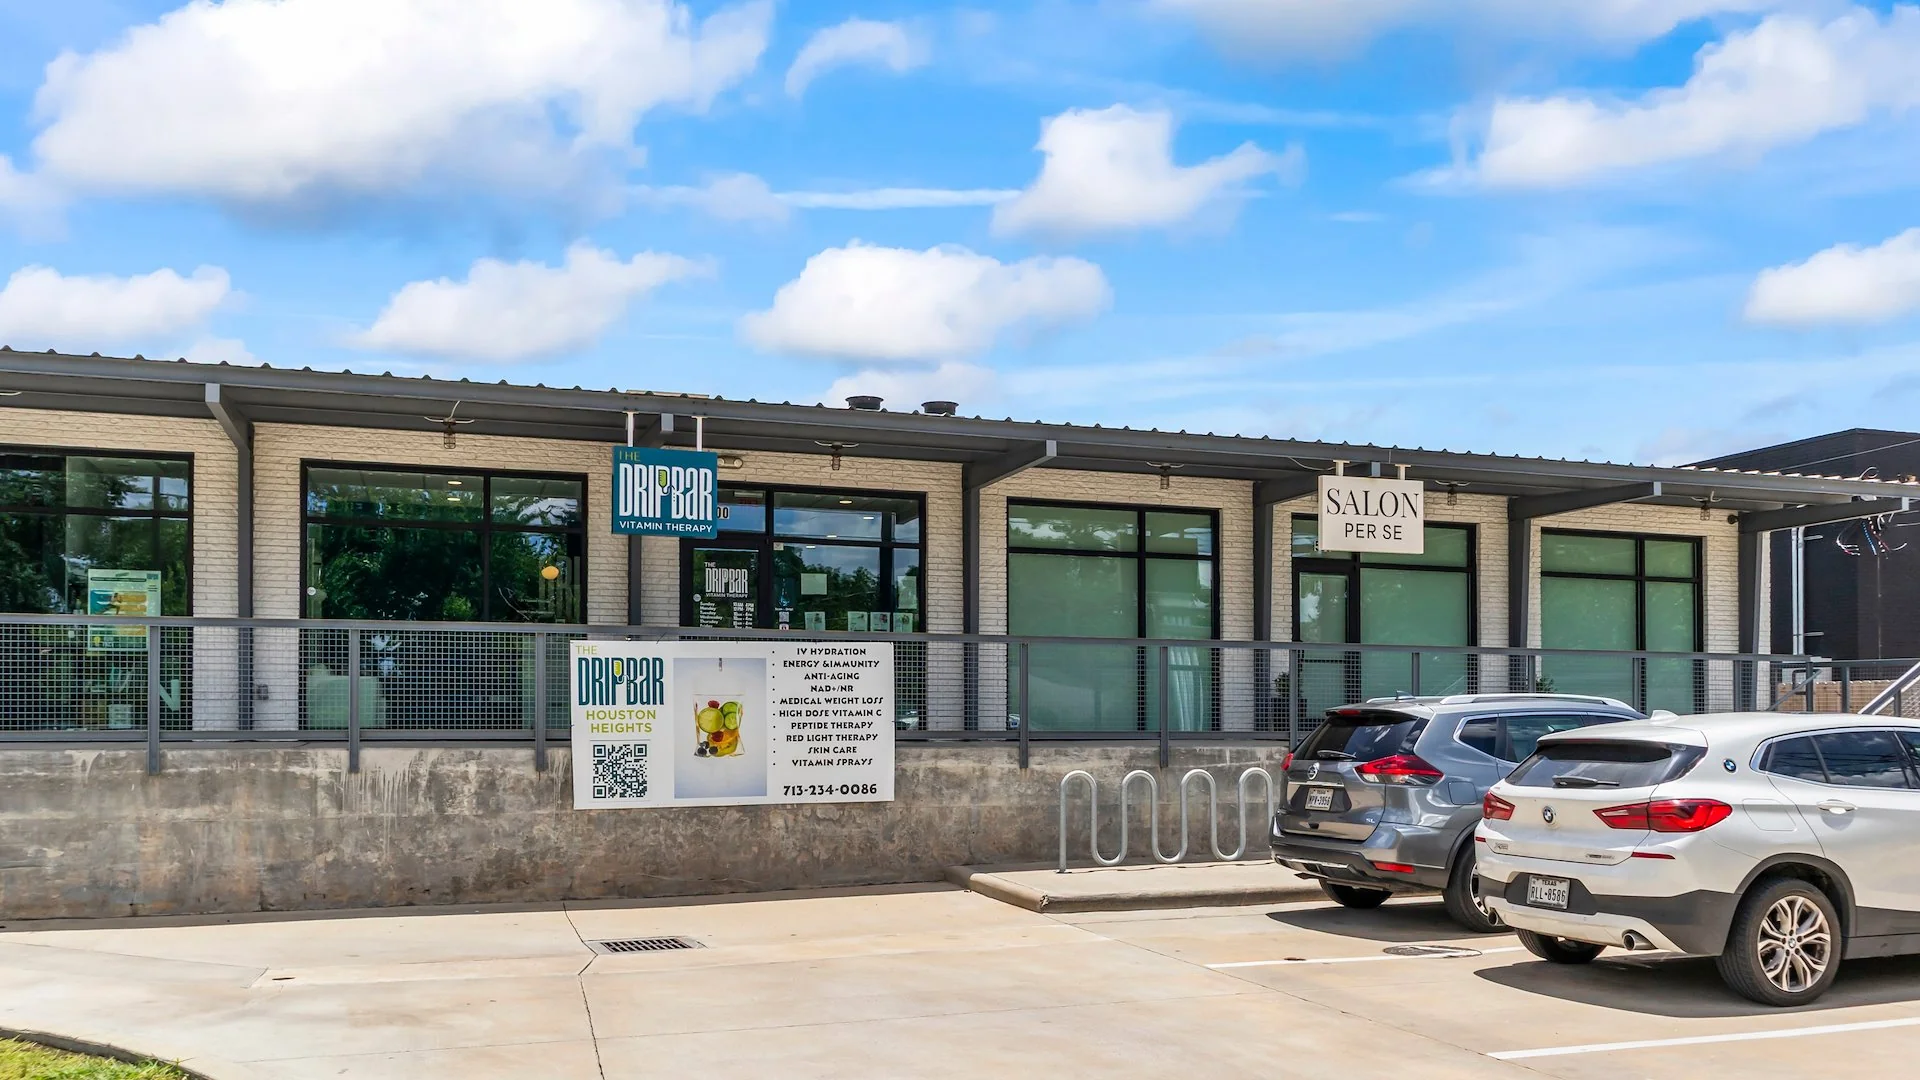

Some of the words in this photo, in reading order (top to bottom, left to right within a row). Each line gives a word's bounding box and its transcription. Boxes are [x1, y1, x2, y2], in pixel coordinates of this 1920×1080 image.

[619, 451, 641, 461] THE
[1326, 487, 1419, 519] SALON
[619, 521, 663, 531] VITAMIN
[665, 523, 713, 533] THERAPY
[1345, 522, 1377, 539] PER
[1382, 524, 1402, 540] SE
[576, 645, 598, 655] THE
[862, 696, 884, 704] LOSS
[586, 709, 656, 720] HOUSTON
[590, 722, 652, 733] HEIGHTS
[791, 722, 828, 730] PEPTIDE
[836, 734, 878, 742] THERAPY
[792, 758, 834, 766] VITAMIN
[836, 758, 873, 766] SPRAYS
[783, 784, 877, 796] 713-234-0086
